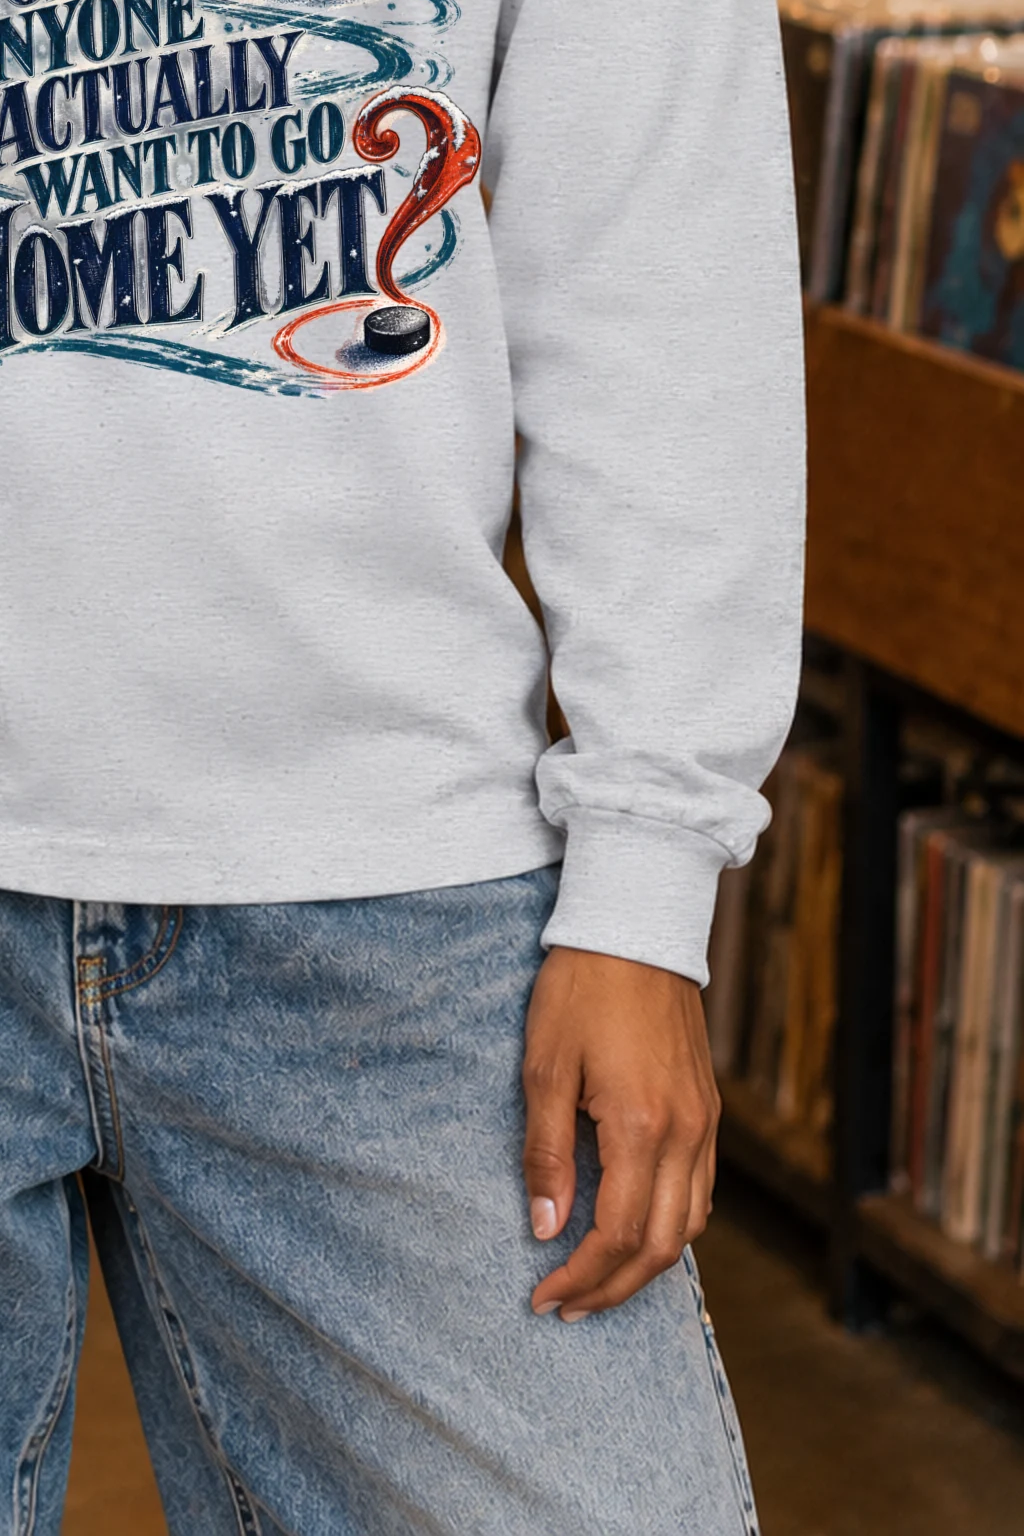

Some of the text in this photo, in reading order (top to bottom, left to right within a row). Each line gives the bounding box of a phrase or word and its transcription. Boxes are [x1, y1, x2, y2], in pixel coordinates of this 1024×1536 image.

[18, 101, 346, 218] WANT TO GO
